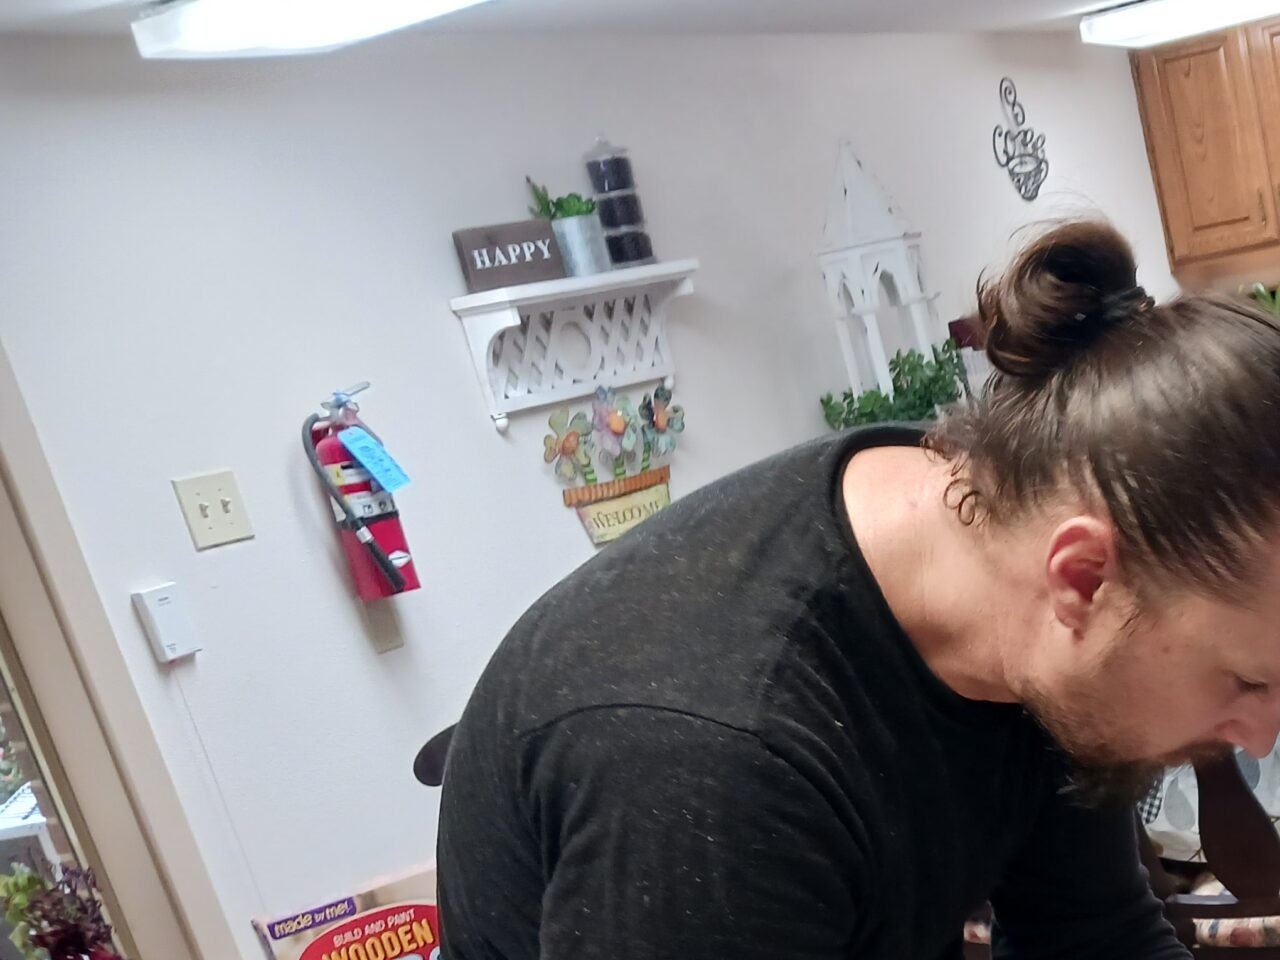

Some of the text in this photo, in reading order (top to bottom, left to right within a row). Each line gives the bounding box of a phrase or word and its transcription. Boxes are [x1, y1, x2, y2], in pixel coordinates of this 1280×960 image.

[473, 239, 551, 270] HAPPY
[274, 900, 351, 937] made by me!
[333, 909, 415, 946] BUILD AND PAINT
